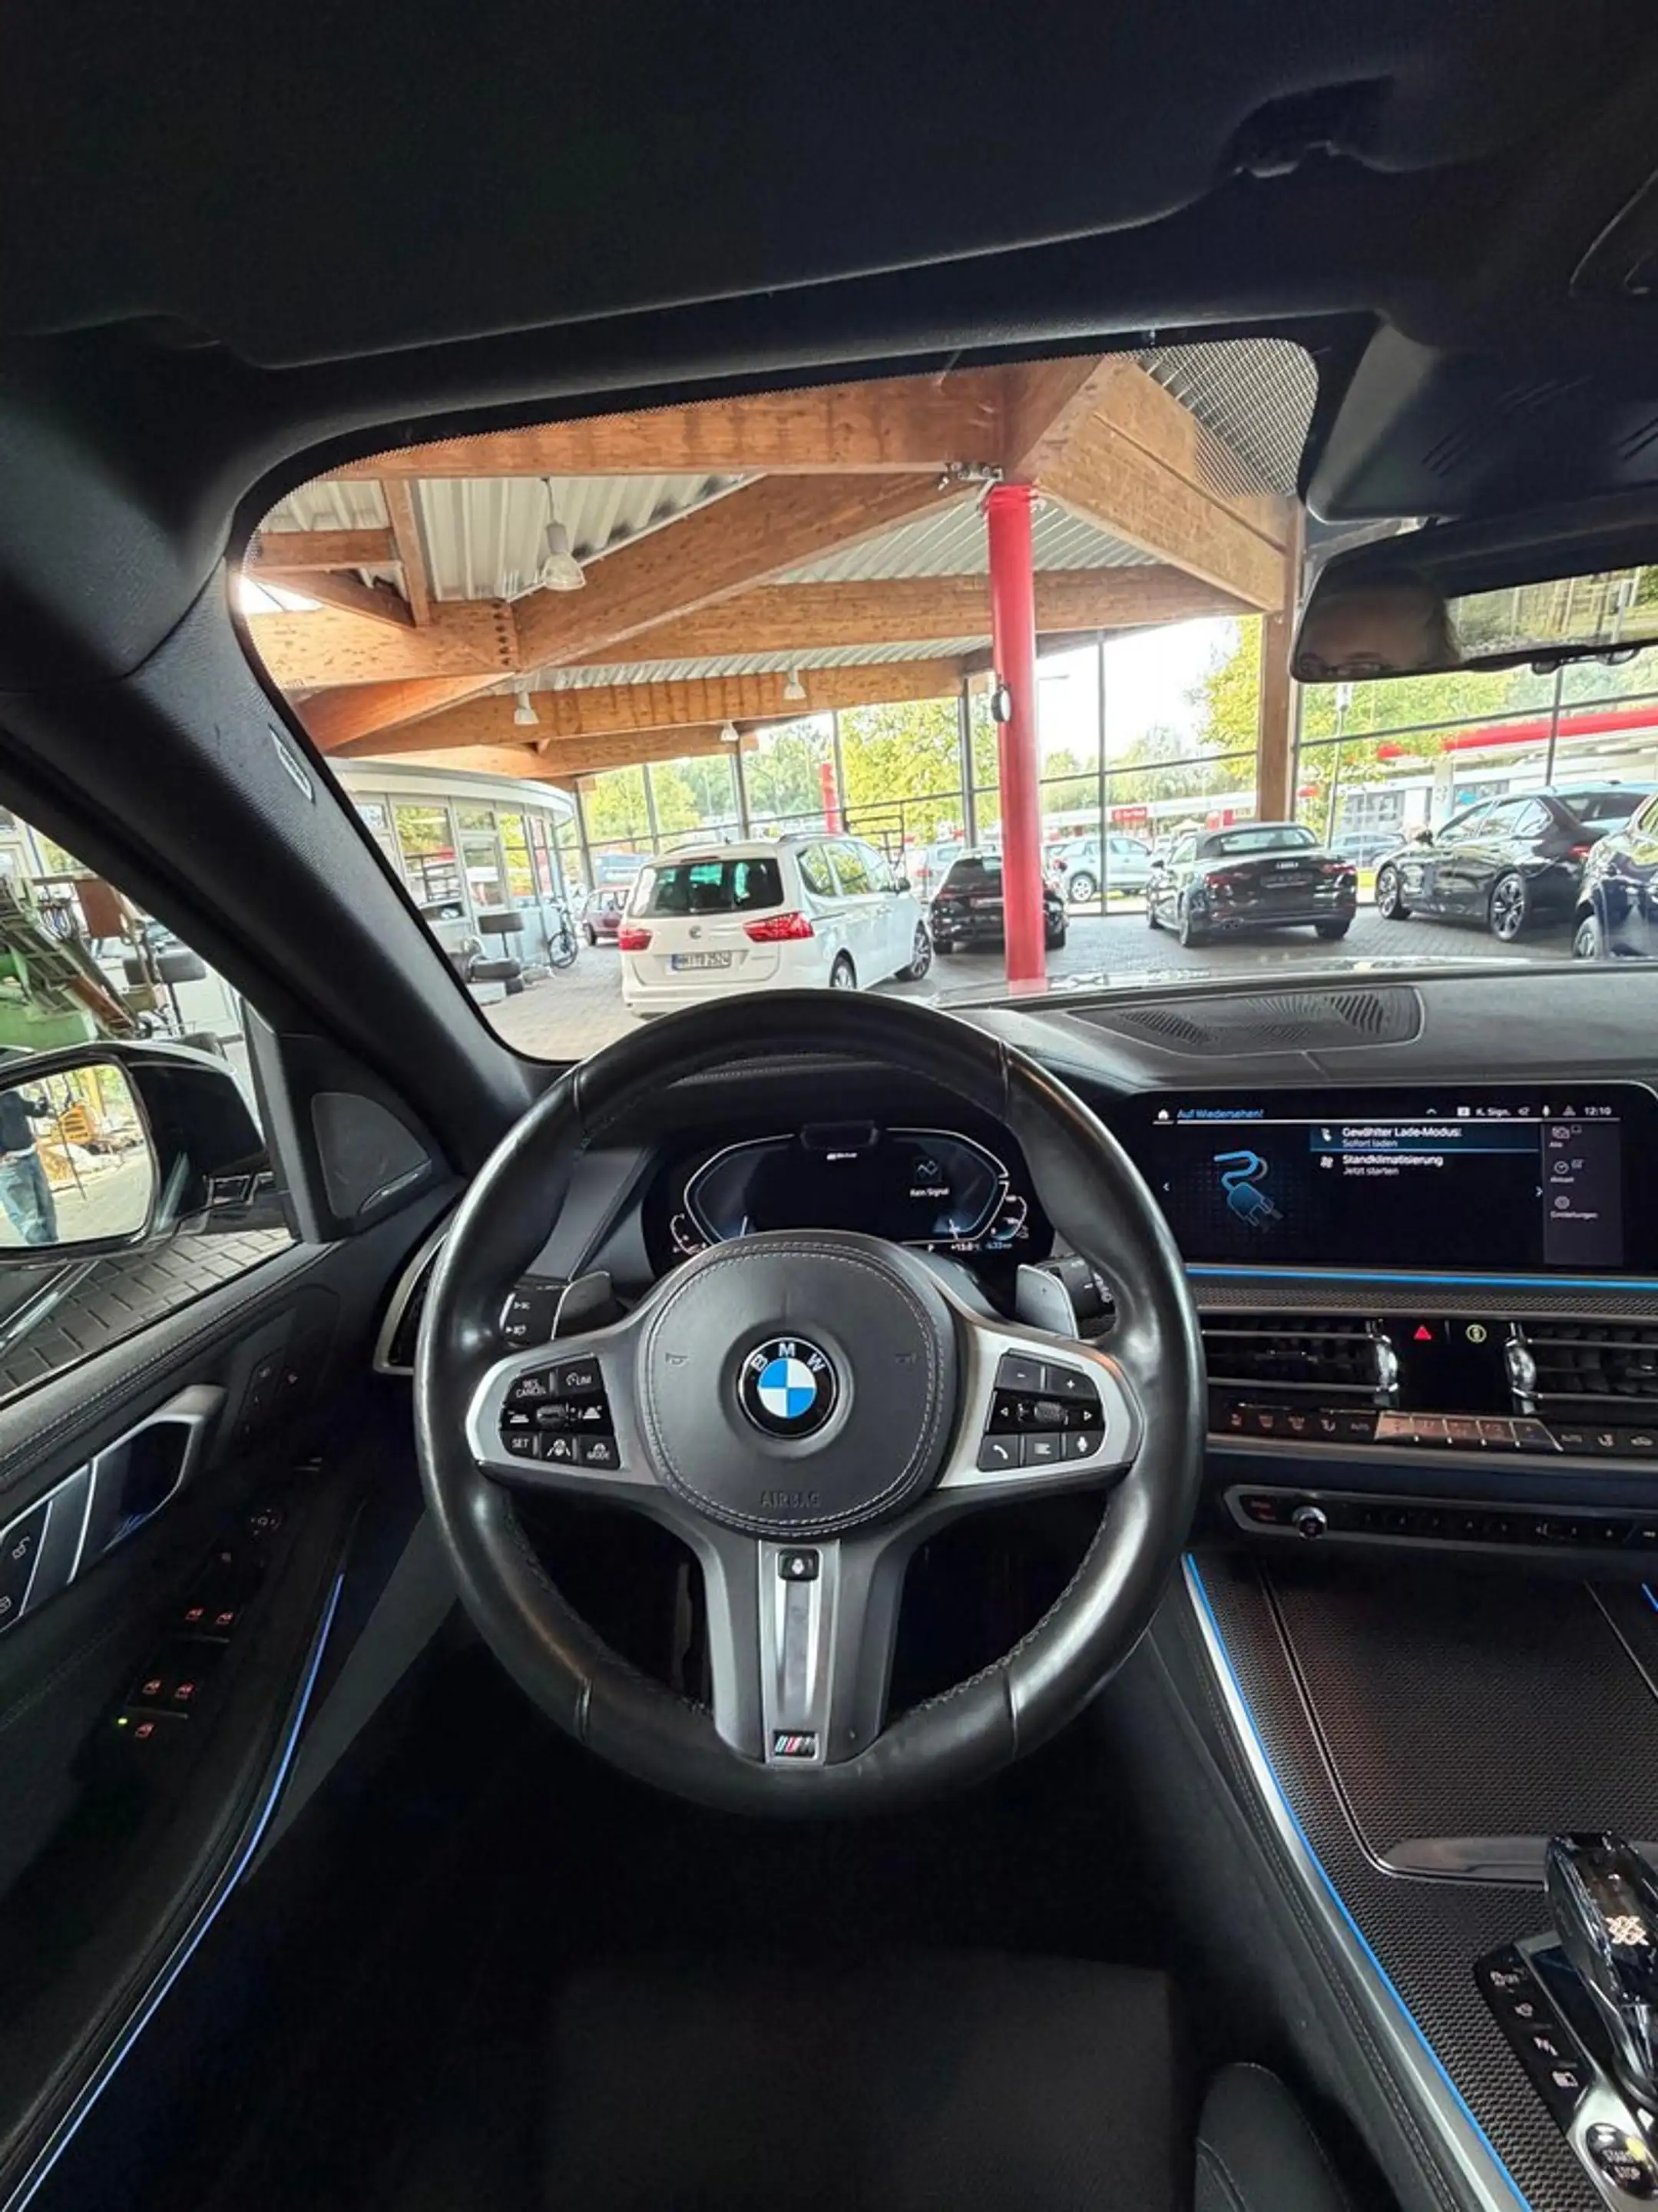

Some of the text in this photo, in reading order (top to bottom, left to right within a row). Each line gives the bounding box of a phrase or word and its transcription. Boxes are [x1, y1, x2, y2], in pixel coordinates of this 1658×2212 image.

[1584, 1107, 1612, 1115] 12:10
[1342, 1127, 1392, 1137] Gewählter
[1342, 1139, 1398, 1147] Sofort laden
[1342, 1154, 1444, 1167] Standklimatisierung
[1343, 1167, 1399, 1176] Jetzt starten
[750, 1343, 826, 1372] BMW
[512, 1438, 529, 1448] SET
[760, 1490, 821, 1508] AIRBAG
